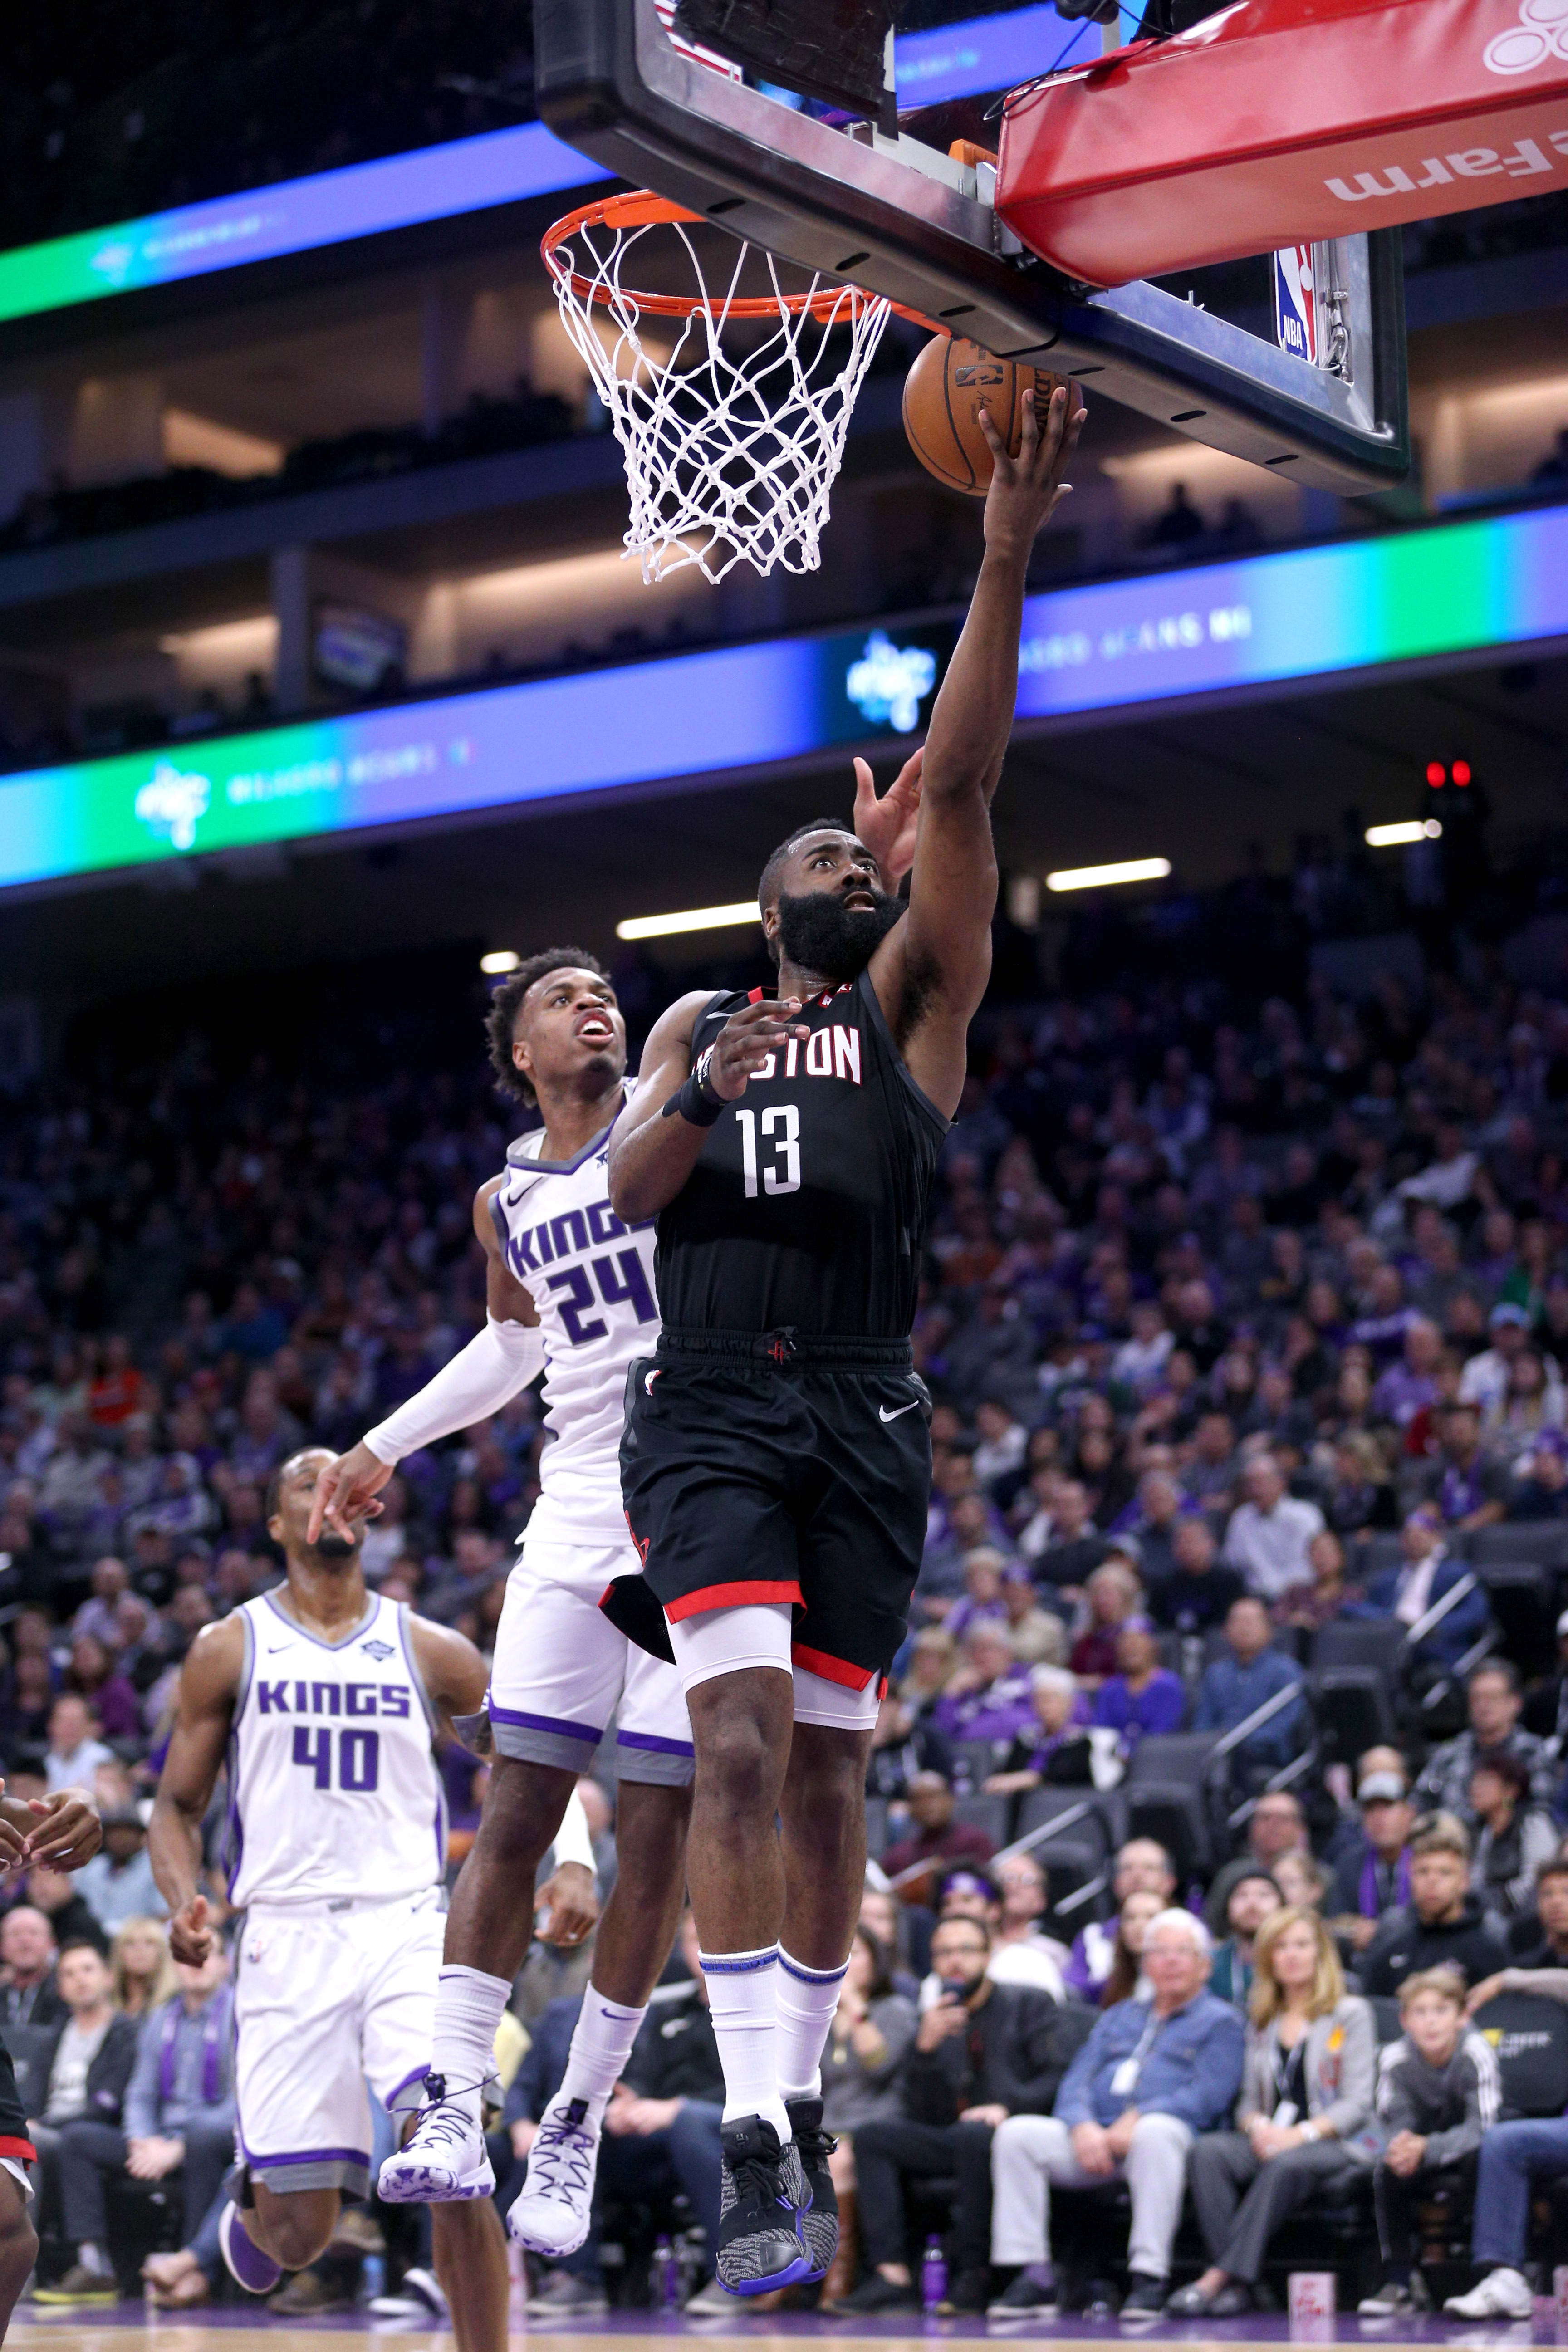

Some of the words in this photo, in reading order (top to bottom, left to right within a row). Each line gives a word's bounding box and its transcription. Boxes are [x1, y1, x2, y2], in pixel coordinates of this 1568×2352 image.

[1323, 139, 1553, 201] Farm
[1283, 314, 1303, 350] NBA
[735, 1104, 801, 1198] 13
[509, 1198, 655, 1279] KING
[545, 1246, 659, 1346] 24
[257, 1681, 410, 1718] KINGS
[292, 1726, 379, 1792] 40
